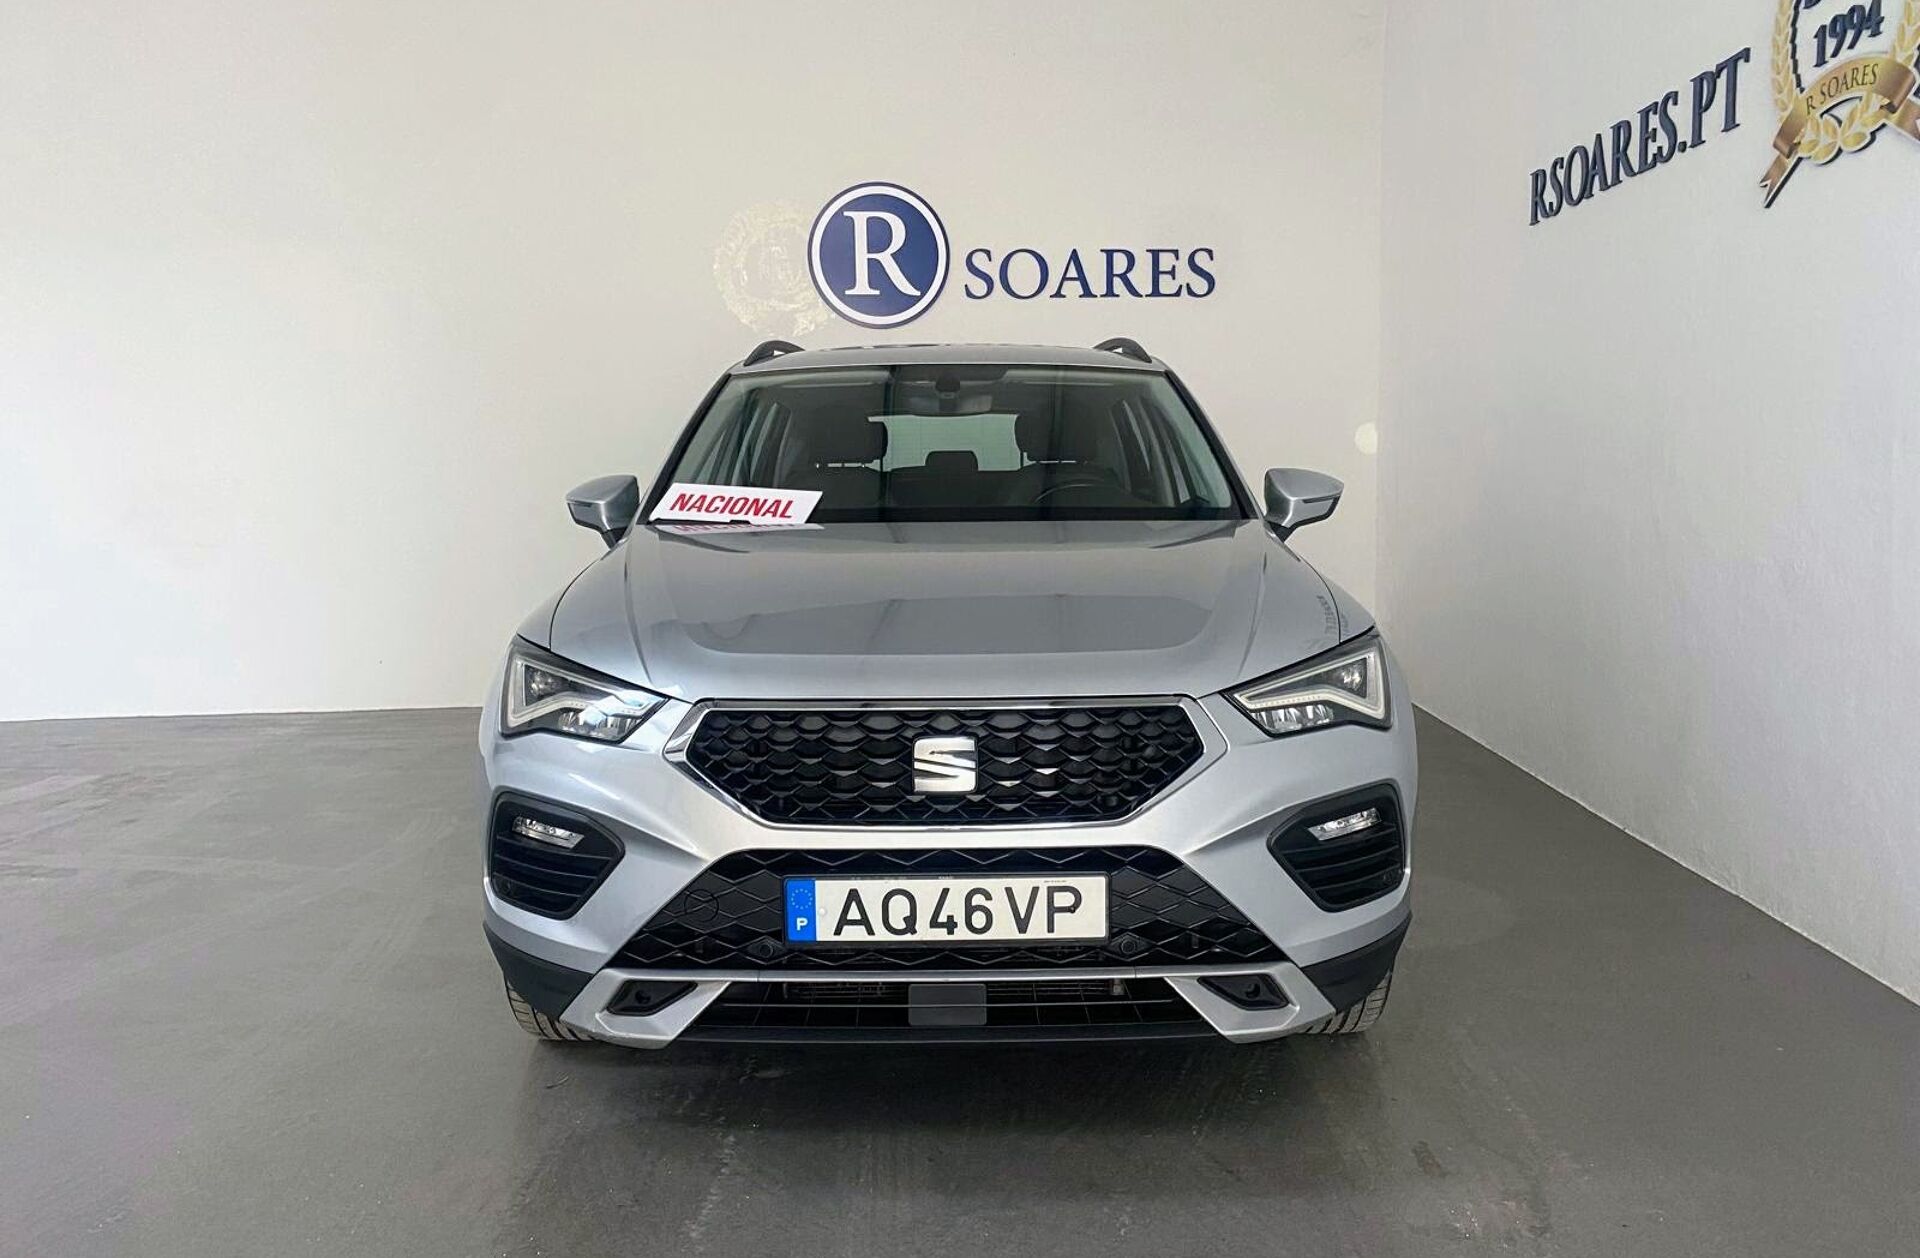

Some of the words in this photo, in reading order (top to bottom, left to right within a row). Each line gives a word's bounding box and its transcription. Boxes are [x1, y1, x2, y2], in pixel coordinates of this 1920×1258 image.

[1813, 0, 1885, 67] 1994
[1820, 63, 1879, 105] SOARES
[1529, 46, 1751, 226] RSOARES.PT
[843, 210, 922, 297] R
[964, 247, 1216, 300] SOARES
[670, 493, 793, 518] NACIONAL
[796, 917, 808, 931] P
